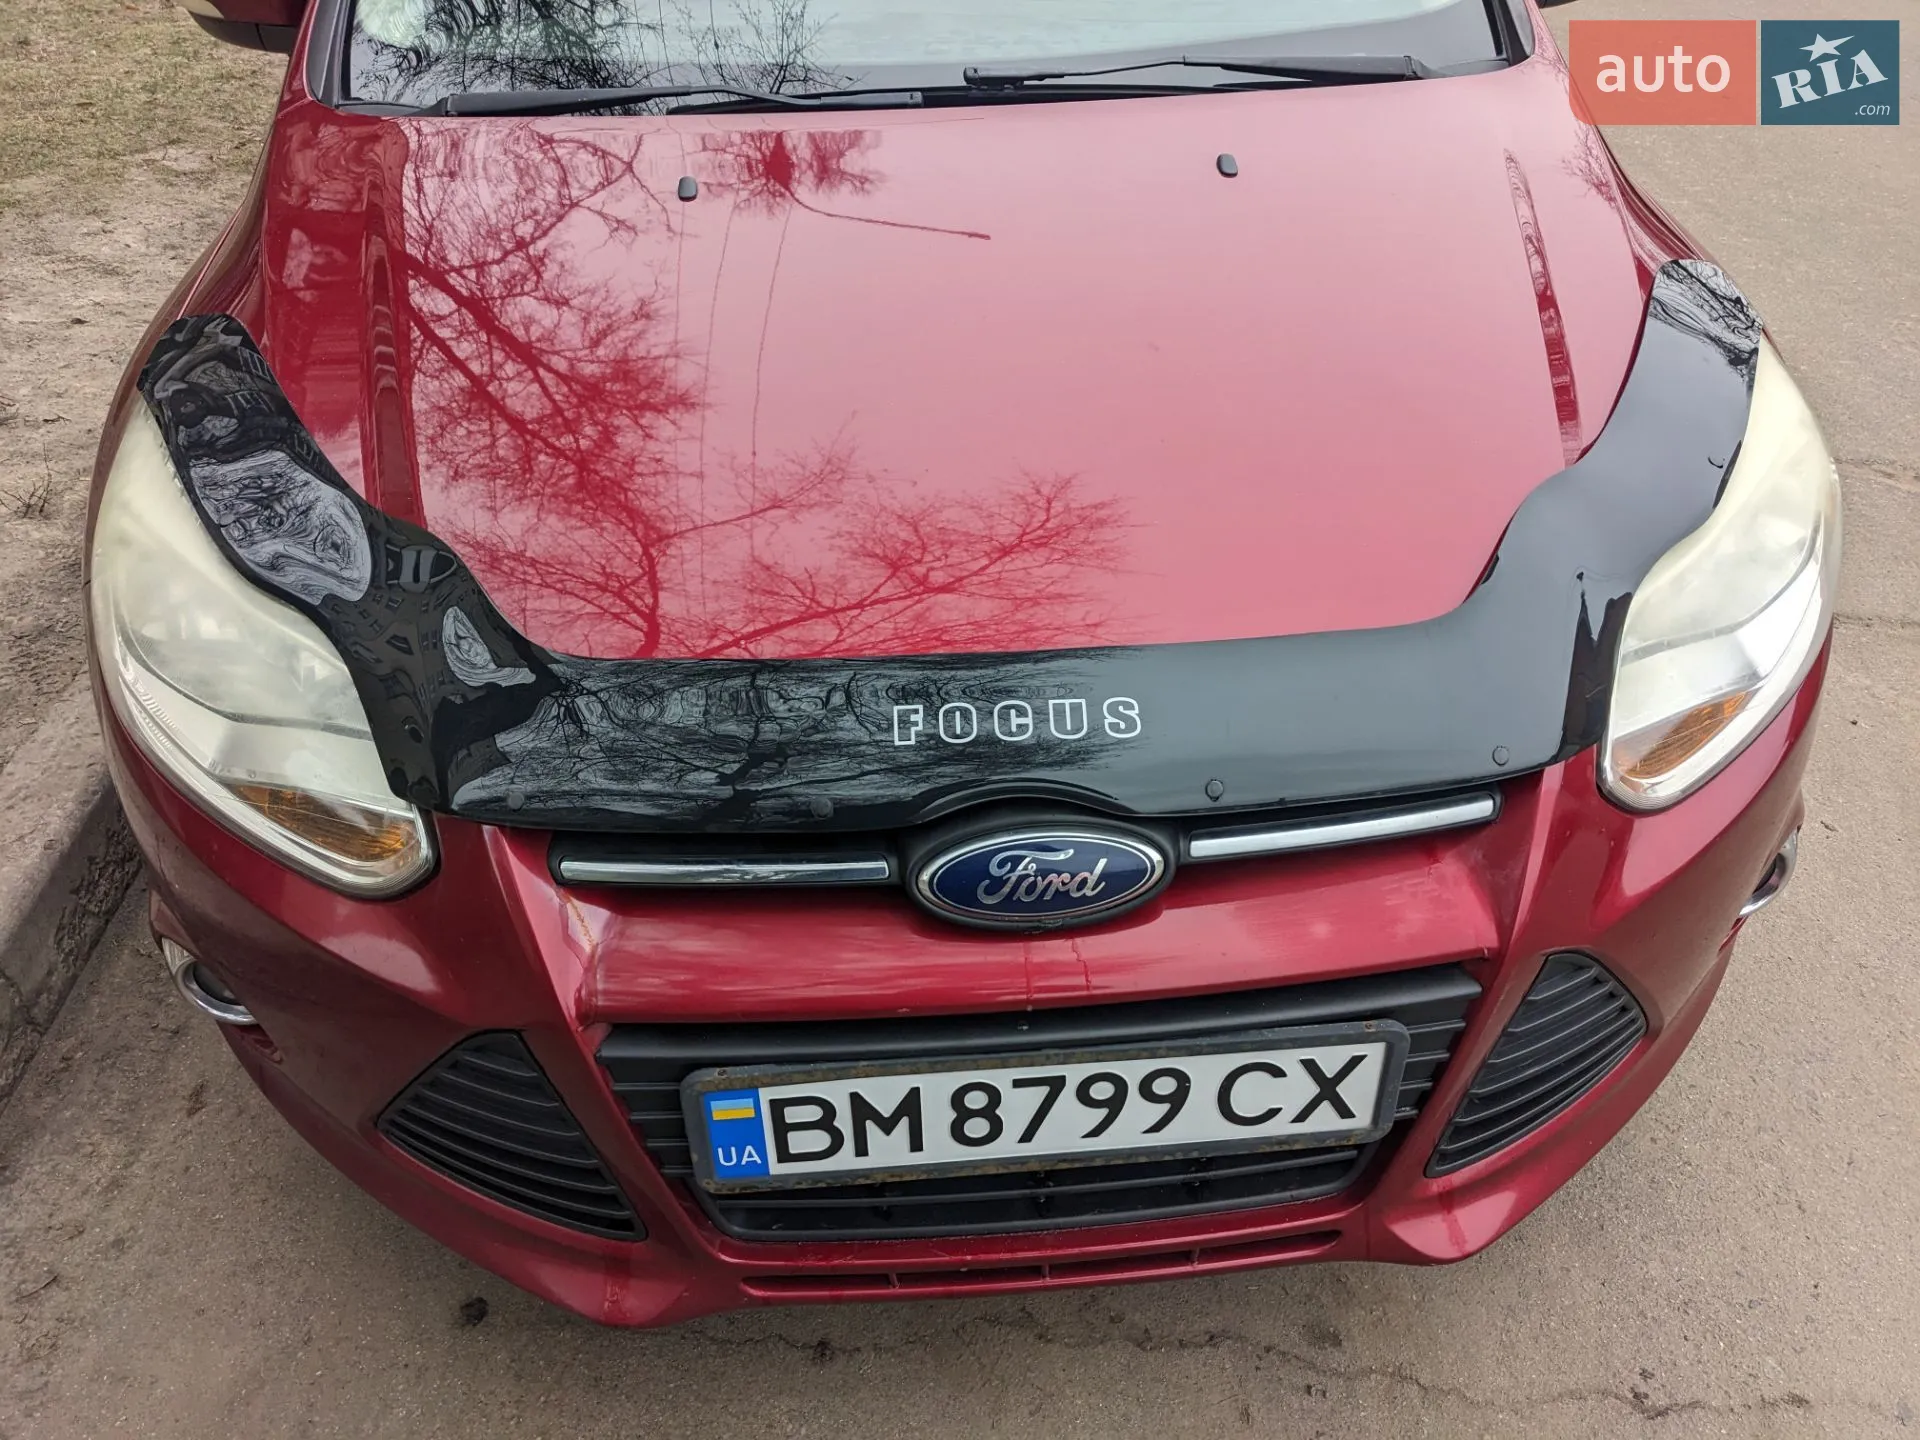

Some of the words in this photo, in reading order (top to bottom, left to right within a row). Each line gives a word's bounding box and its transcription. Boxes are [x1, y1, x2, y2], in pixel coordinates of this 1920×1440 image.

[893, 697, 1142, 746] FOCUS
[976, 848, 1108, 905] Ford
[768, 1087, 924, 1164] BM
[948, 1067, 1192, 1147] 8799
[1216, 1053, 1369, 1127] CX
[717, 1144, 762, 1167] UA
